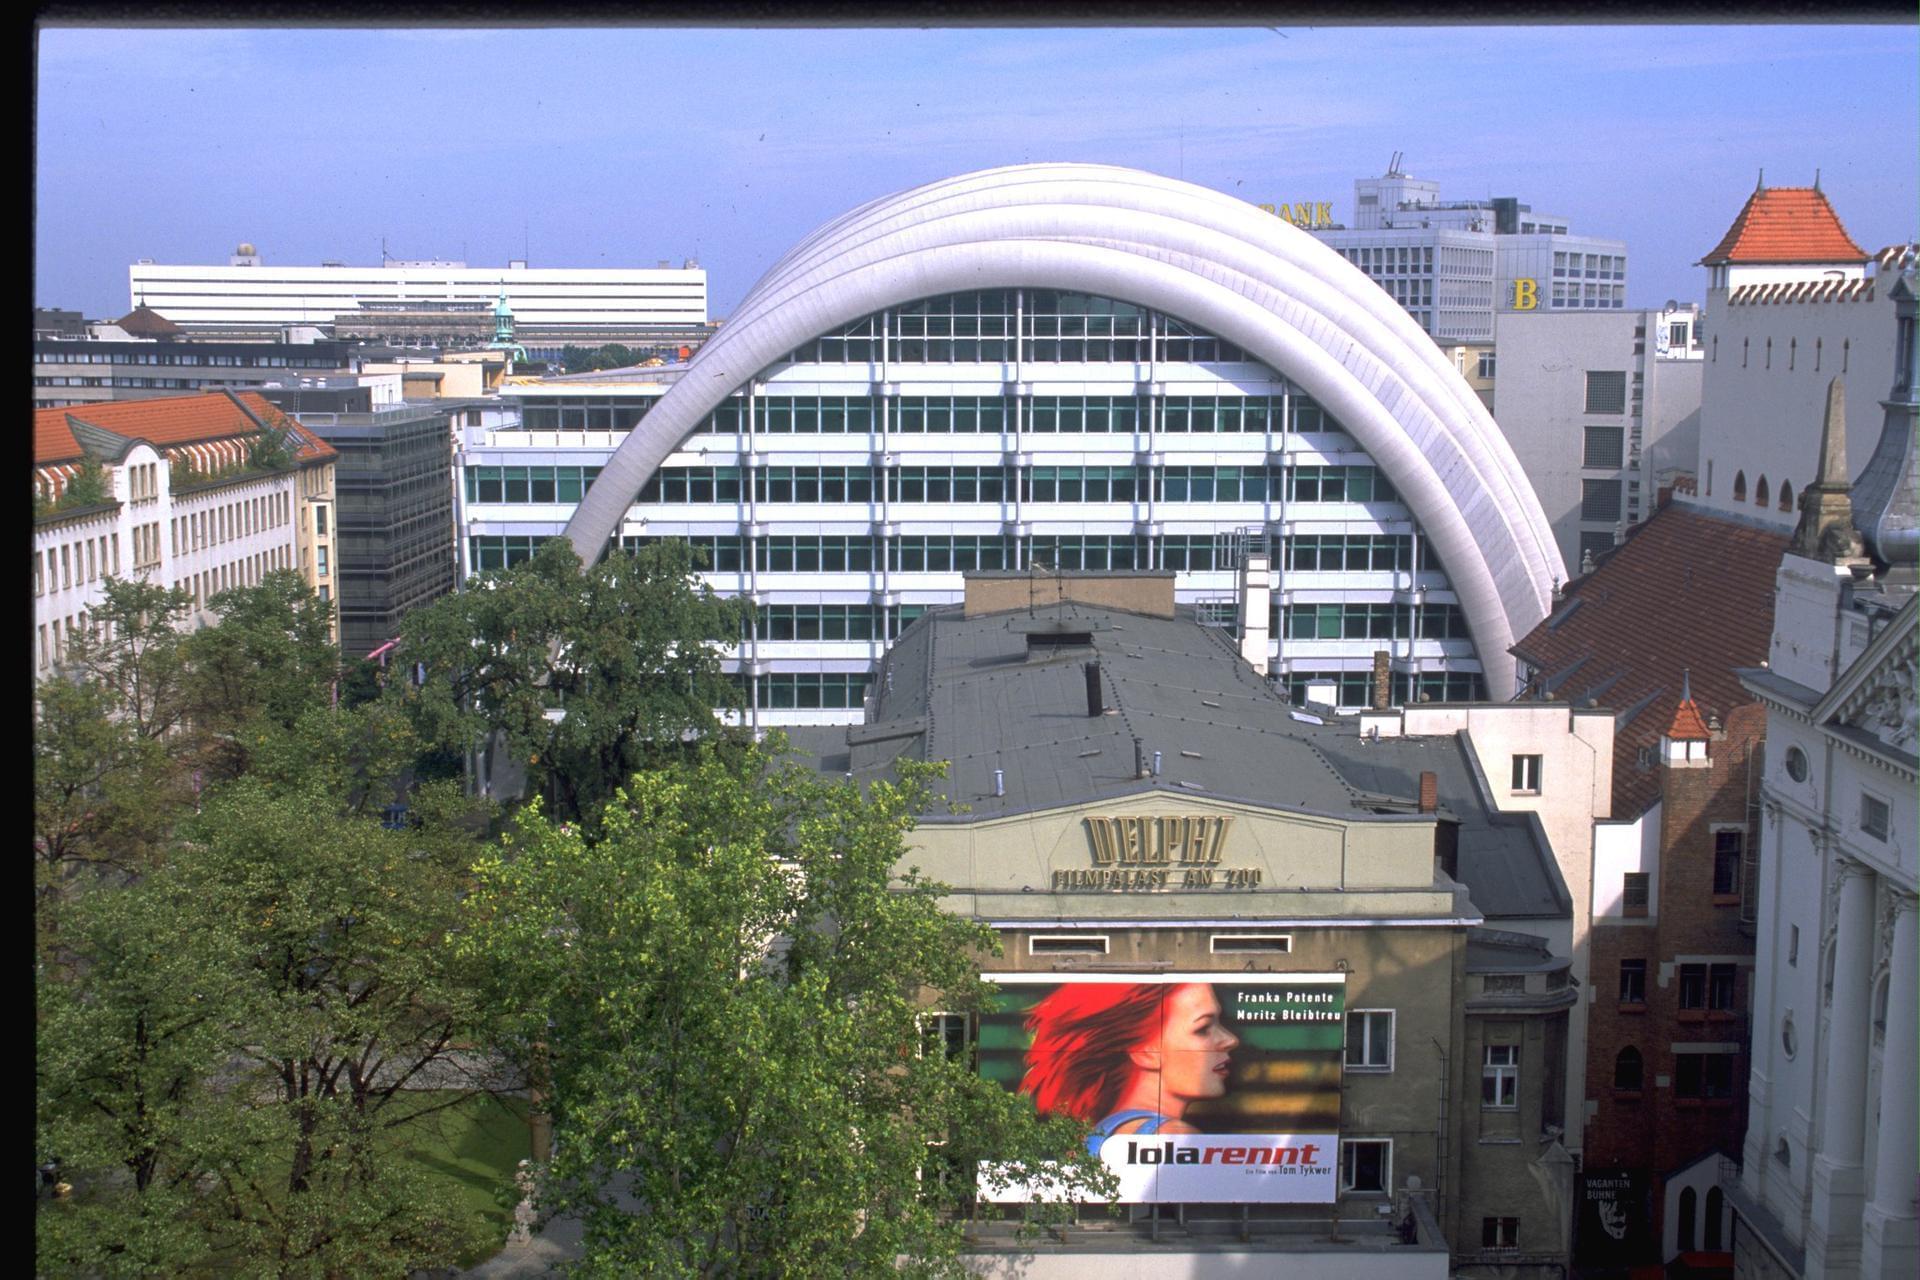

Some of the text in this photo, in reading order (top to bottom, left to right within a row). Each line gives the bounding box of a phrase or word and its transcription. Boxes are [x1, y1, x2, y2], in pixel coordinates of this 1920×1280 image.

[1513, 278, 1537, 310] B
[1085, 816, 1235, 864] DELPHI
[1055, 868, 1262, 886] FILMPALAST AM ZOO
[1238, 992, 1333, 1003] Franka Potente
[1237, 1009, 1341, 1020] Moritz Bleibtreu
[1279, 1165, 1297, 1175] Tom
[1300, 1164, 1331, 1176] Tykwer
[1586, 1179, 1631, 1189] VAGANTEN
